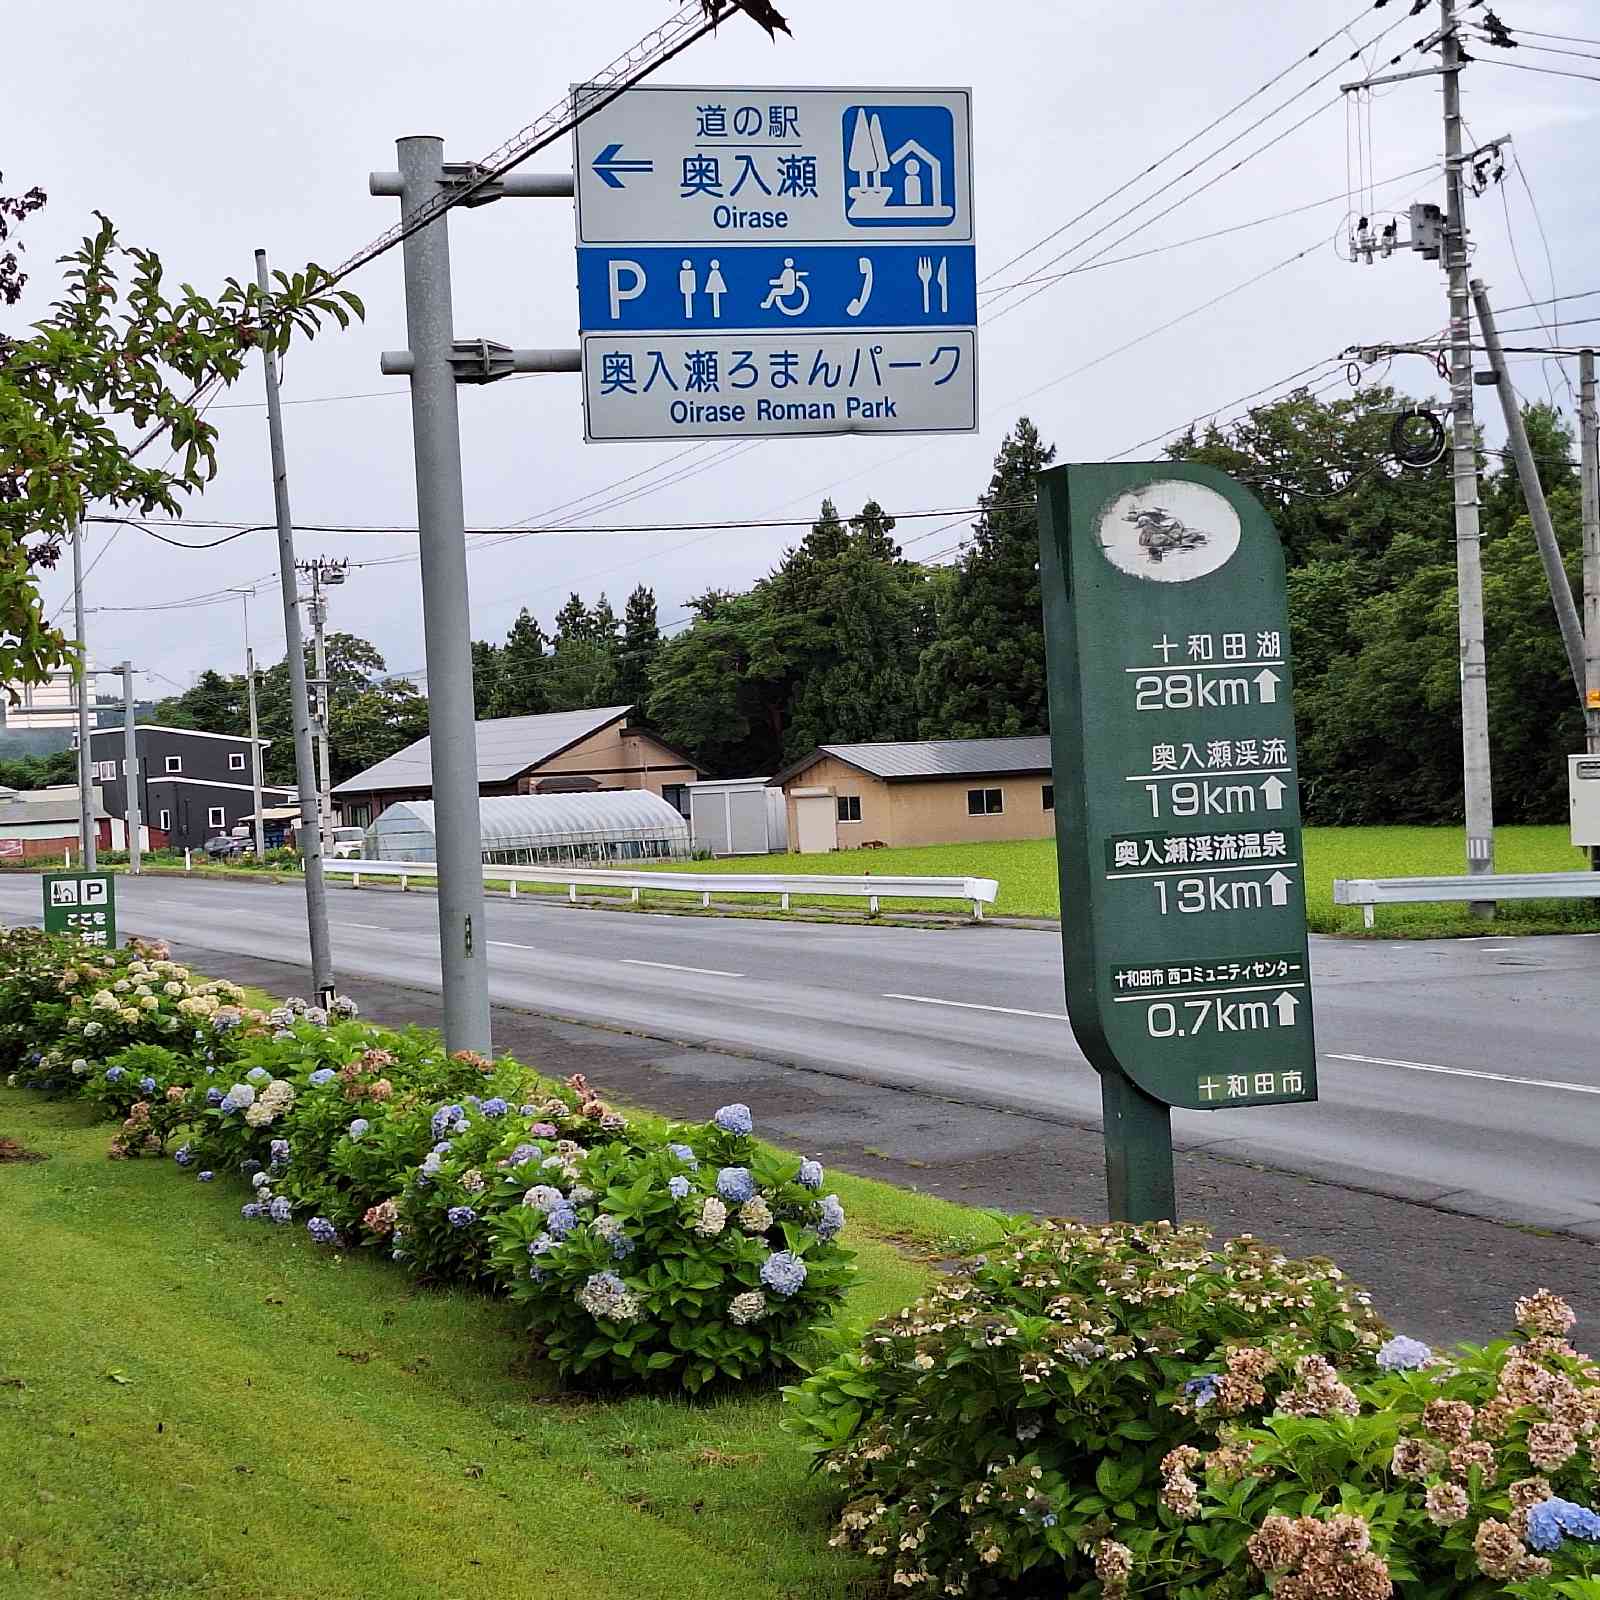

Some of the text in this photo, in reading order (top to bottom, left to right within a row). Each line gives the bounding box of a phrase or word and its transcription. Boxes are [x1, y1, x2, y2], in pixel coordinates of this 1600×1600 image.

[696, 105, 801, 137] 道の駅
[680, 153, 818, 198] 奥入瀬
[713, 205, 788, 229] Oirase
[600, 345, 960, 395] 奥入瀬ろまんパーク
[670, 396, 897, 424] Oirase Roman Park
[1153, 631, 1281, 663] 十和田湖
[1135, 673, 1250, 710] 28km
[1151, 738, 1288, 772] 奥入瀬渓流
[1145, 781, 1256, 817] 19km
[1114, 831, 1287, 868] 奥入瀬渓流温泉
[1153, 877, 1262, 915] 13km
[1114, 968, 1164, 988] 十和田市
[1147, 998, 1269, 1038] 0.7km
[1199, 1070, 1303, 1100] 十和田市
